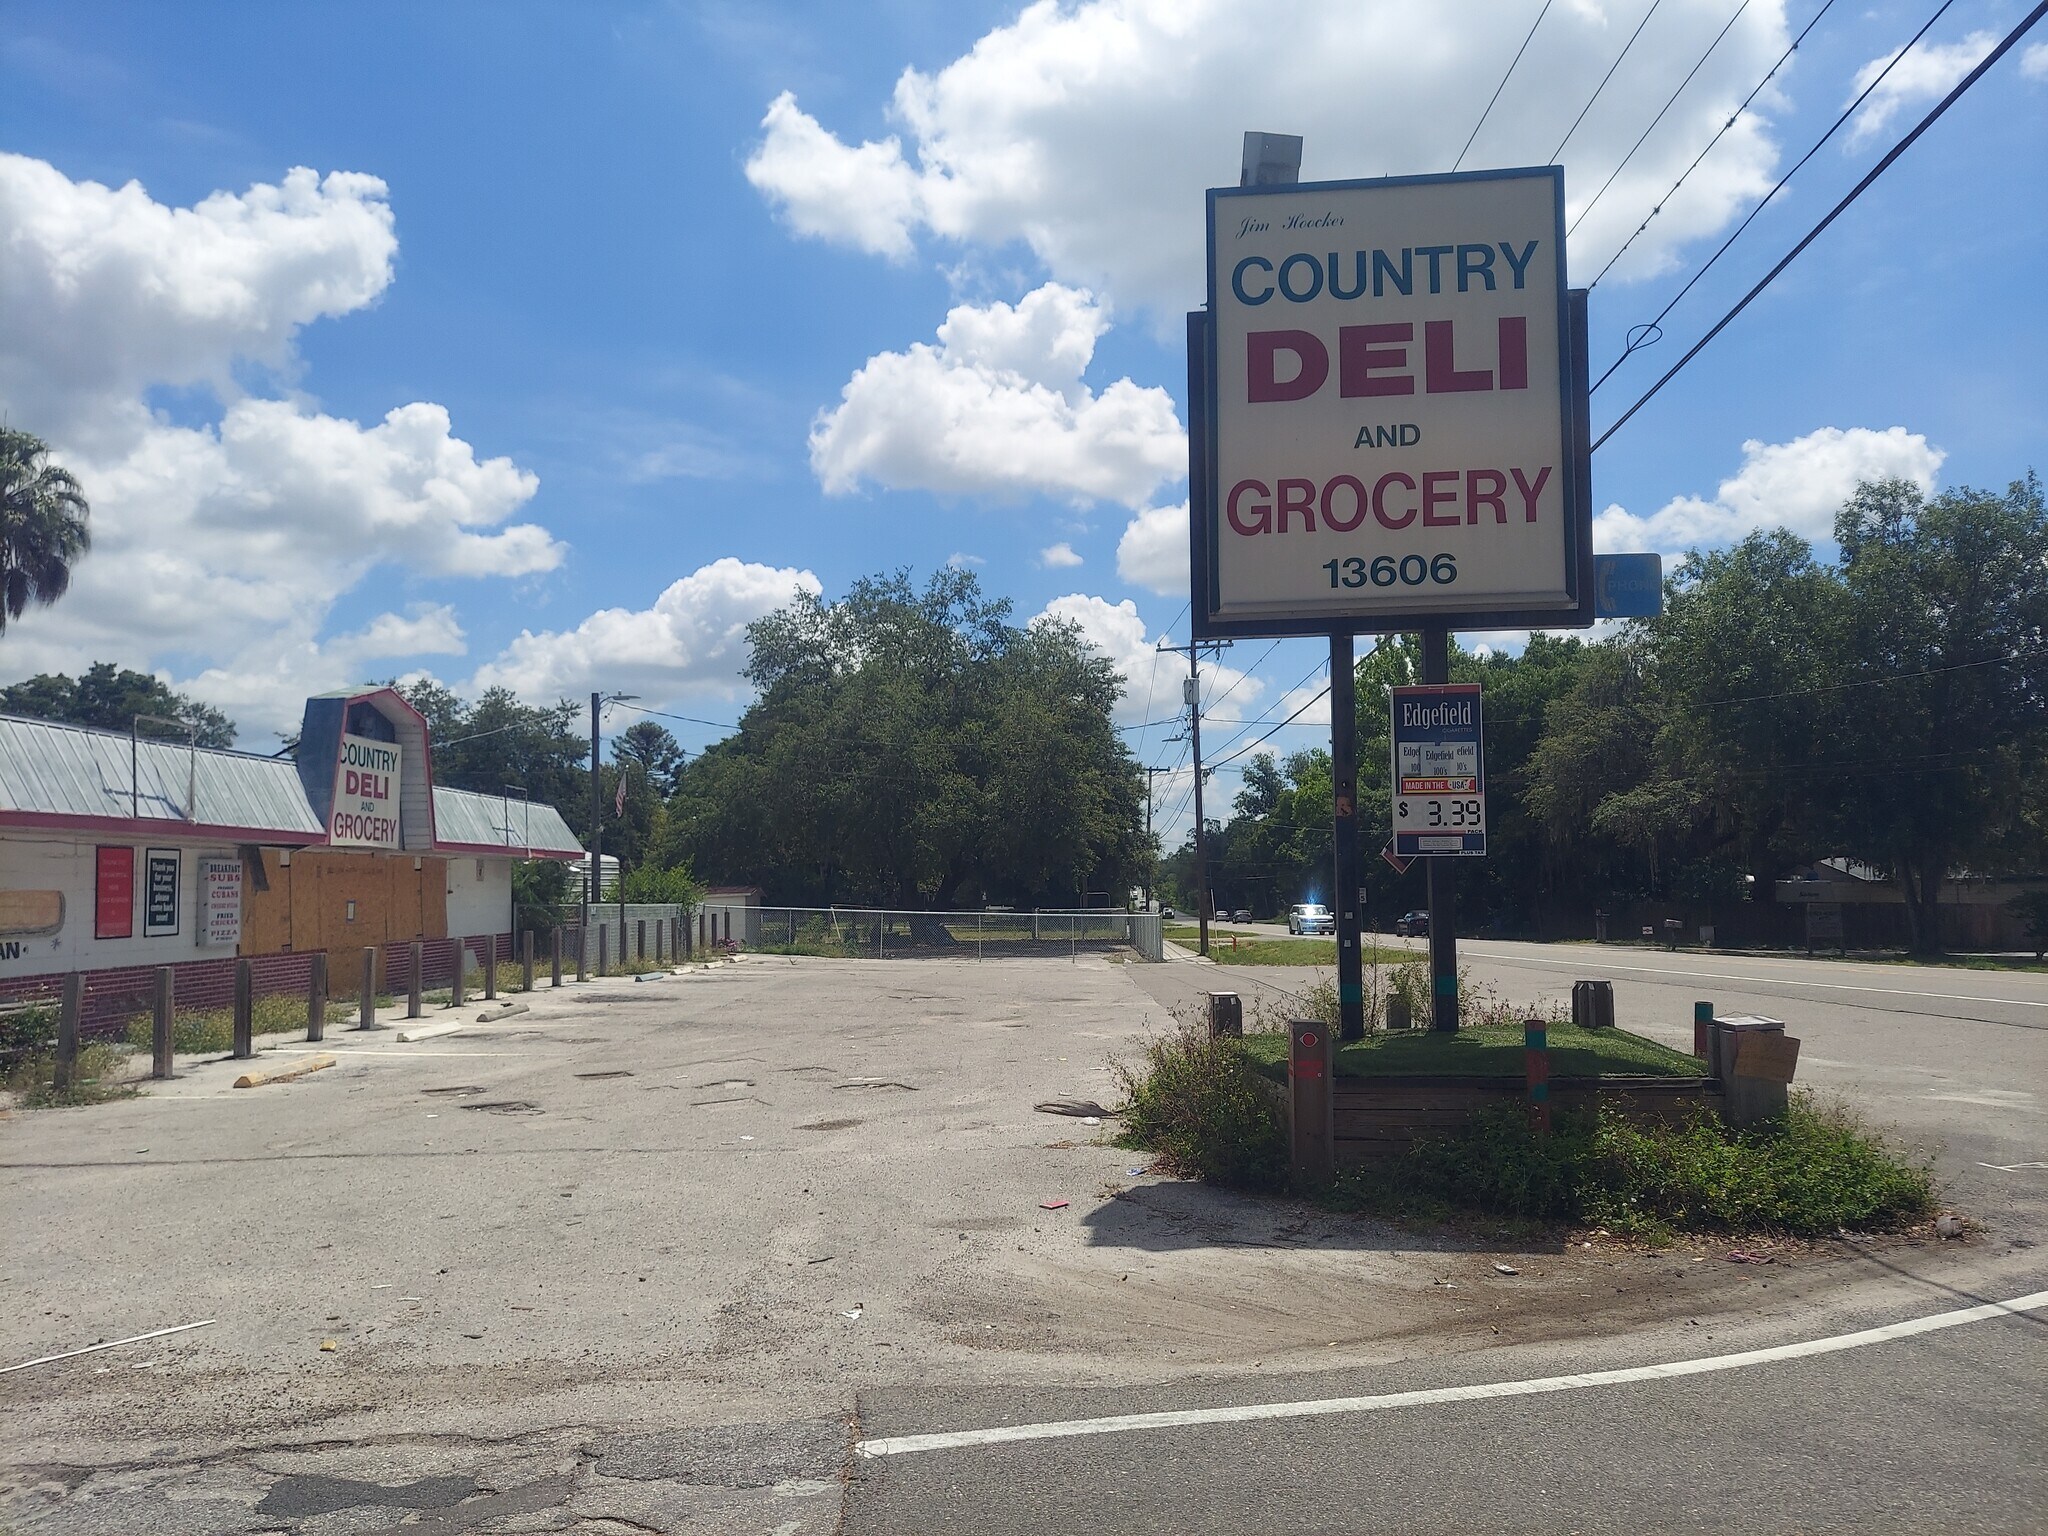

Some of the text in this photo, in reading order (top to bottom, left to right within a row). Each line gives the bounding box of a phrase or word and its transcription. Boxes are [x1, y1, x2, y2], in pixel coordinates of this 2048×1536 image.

[1235, 215, 1270, 240] Jim
[1231, 240, 1540, 306] COUNTRY
[1247, 316, 1528, 403] DELI
[1354, 424, 1421, 449] AND
[1226, 466, 1553, 537] GROCERY
[1322, 553, 1458, 588] 13606
[1403, 701, 1472, 730] Edgefield
[340, 742, 398, 772] COUNTRY
[1425, 750, 1454, 761] Edgefield
[1433, 766, 1448, 775] 100's
[346, 770, 389, 800] DELI
[1405, 780, 1464, 790] MADE IN THE USA
[360, 801, 375, 812] AND
[1399, 800, 1481, 826] $ 3.39
[334, 812, 397, 842] GROCERY
[153, 862, 175, 874] Thank you
[210, 864, 240, 873] BREAKFAST
